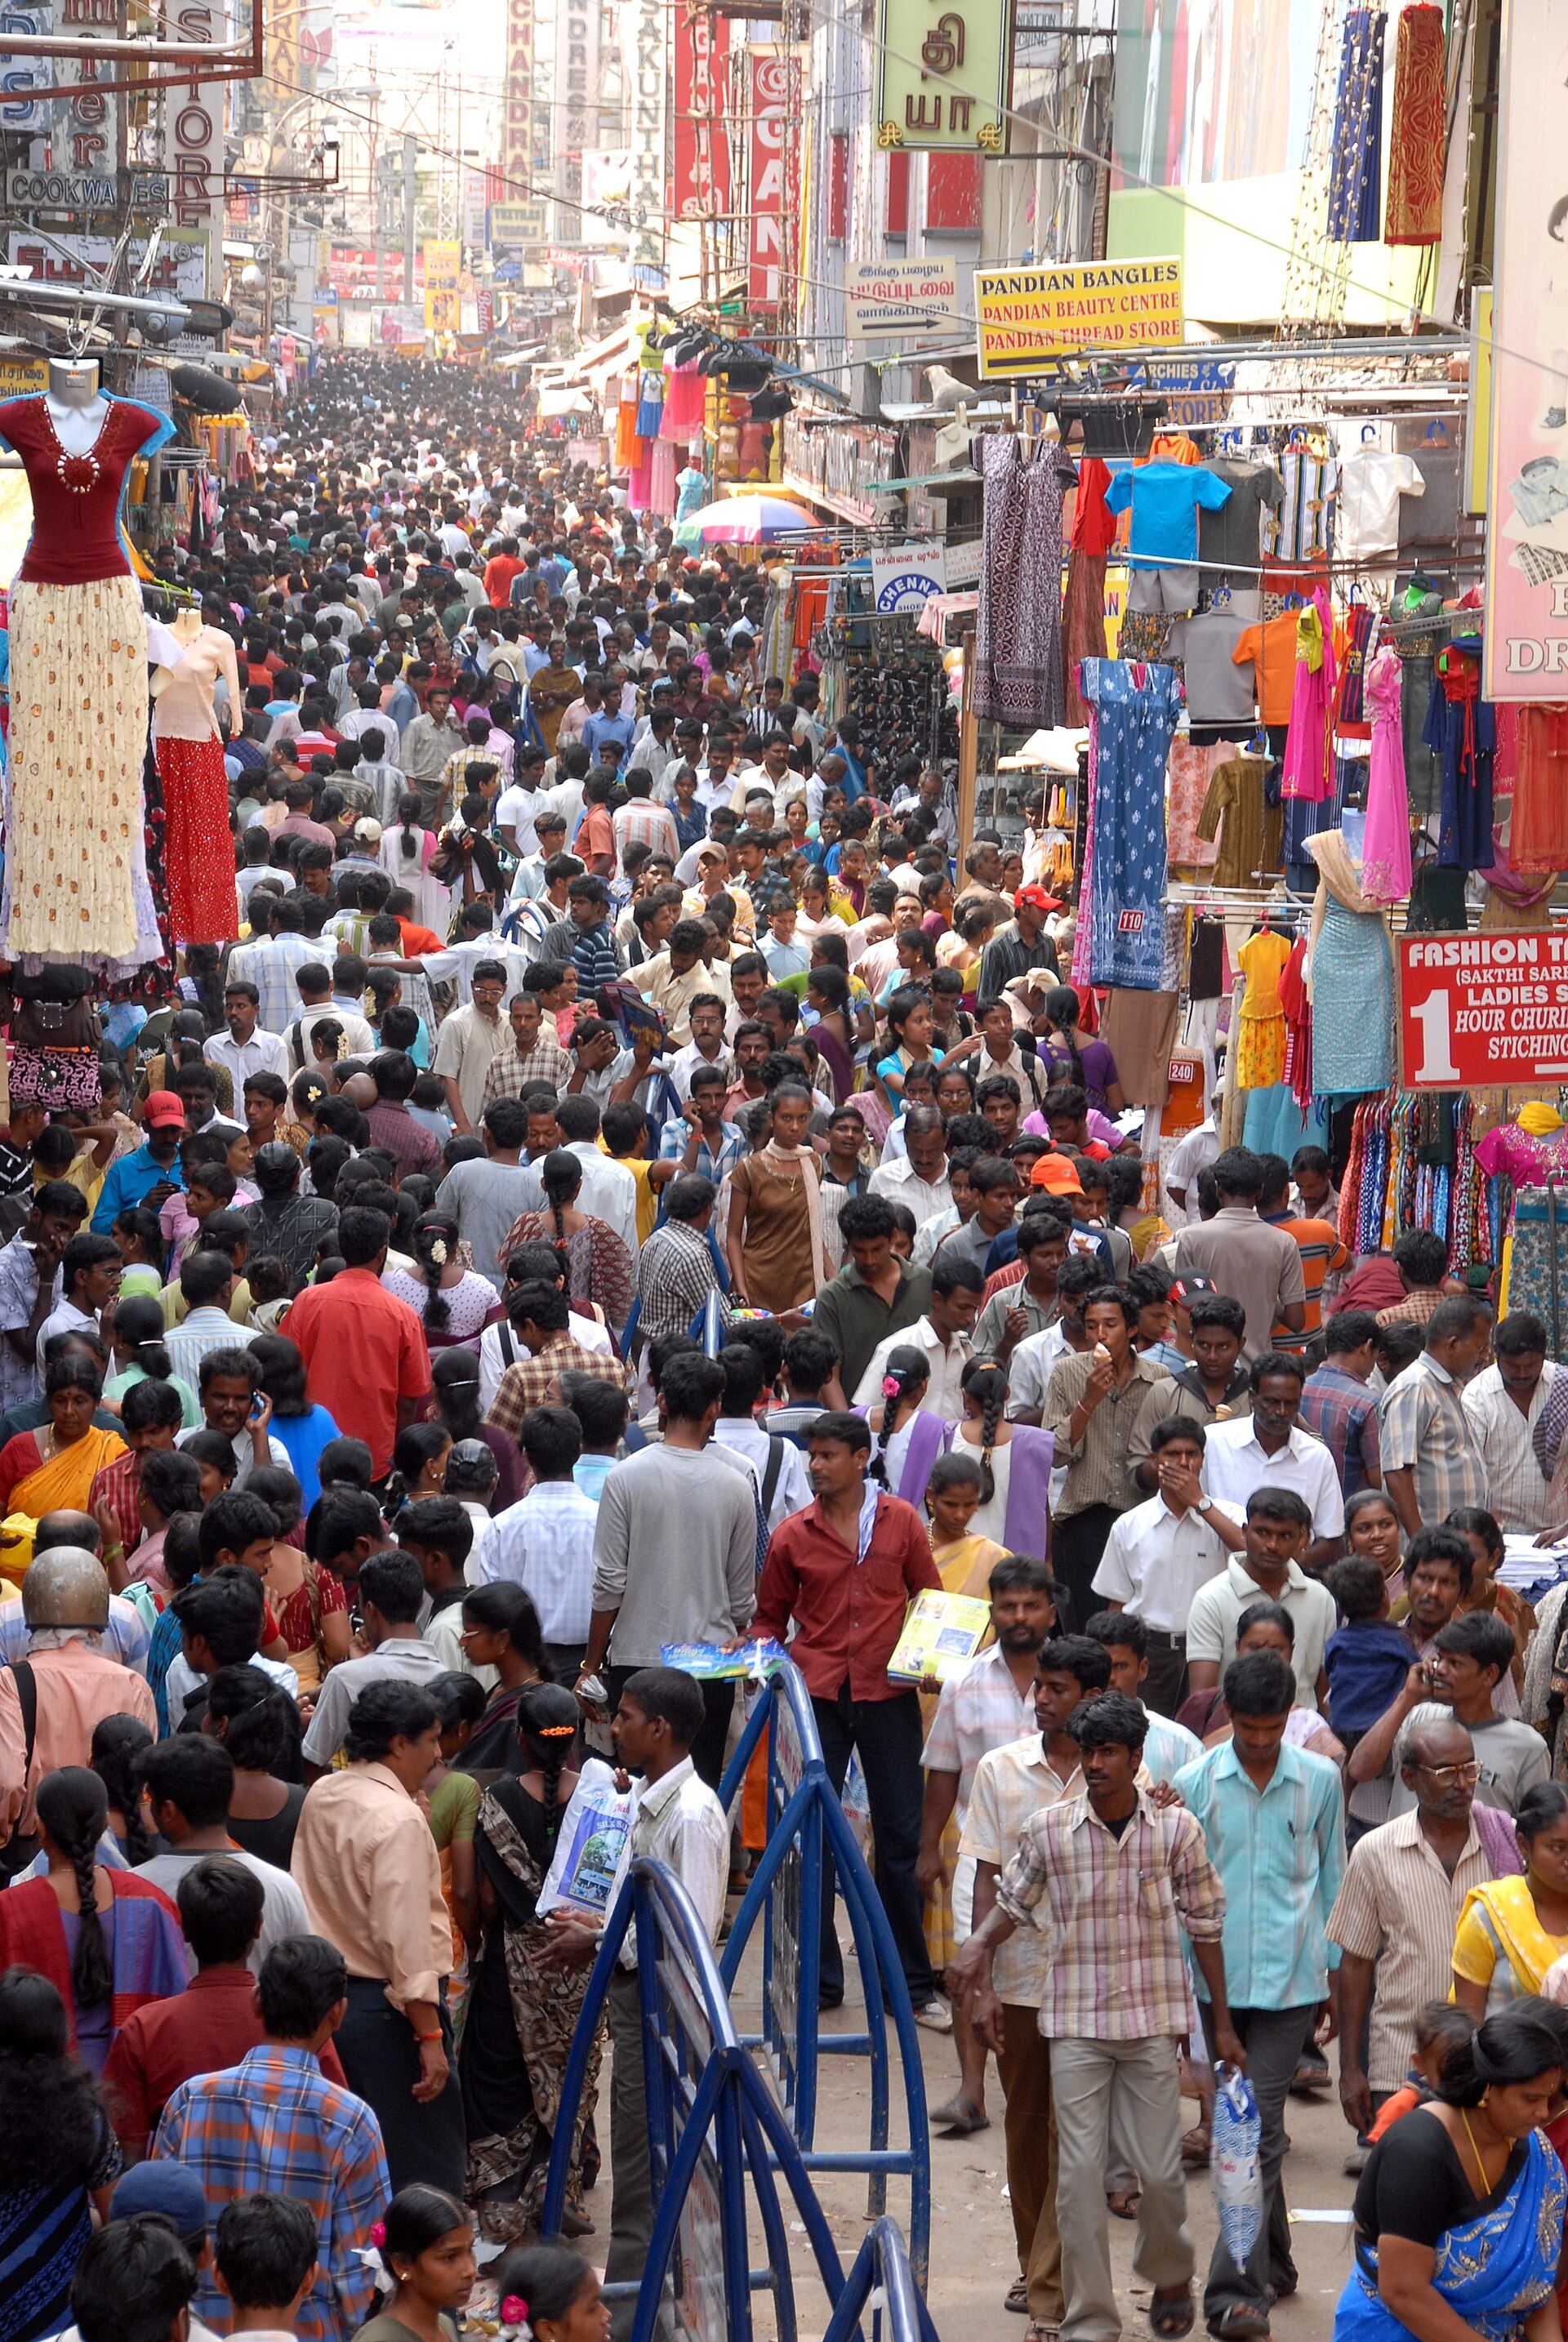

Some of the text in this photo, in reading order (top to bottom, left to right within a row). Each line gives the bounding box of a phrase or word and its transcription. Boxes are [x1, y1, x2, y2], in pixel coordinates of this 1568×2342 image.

[635, 0, 662, 261] SAKUNTHAA
[12, 175, 166, 205] COOKWAES
[982, 265, 1178, 296] PANDIAN BANGLES
[983, 292, 1179, 323] PANDIAN BEAUTY CENTRE
[180, 332, 207, 341] UDIO
[985, 319, 1180, 350] PANDIAN THREAD STORE
[1134, 363, 1199, 379] ARCHIES
[1123, 912, 1142, 929] 110
[1409, 937, 1568, 968] FASHION T
[1455, 968, 1525, 987] (SAKTHI
[1468, 985, 1549, 1007] LADIES
[1454, 1008, 1506, 1034] HOUR
[1410, 988, 1461, 1083] 1
[1488, 1034, 1568, 1060] STICHING
[1171, 1065, 1192, 1080] 240
